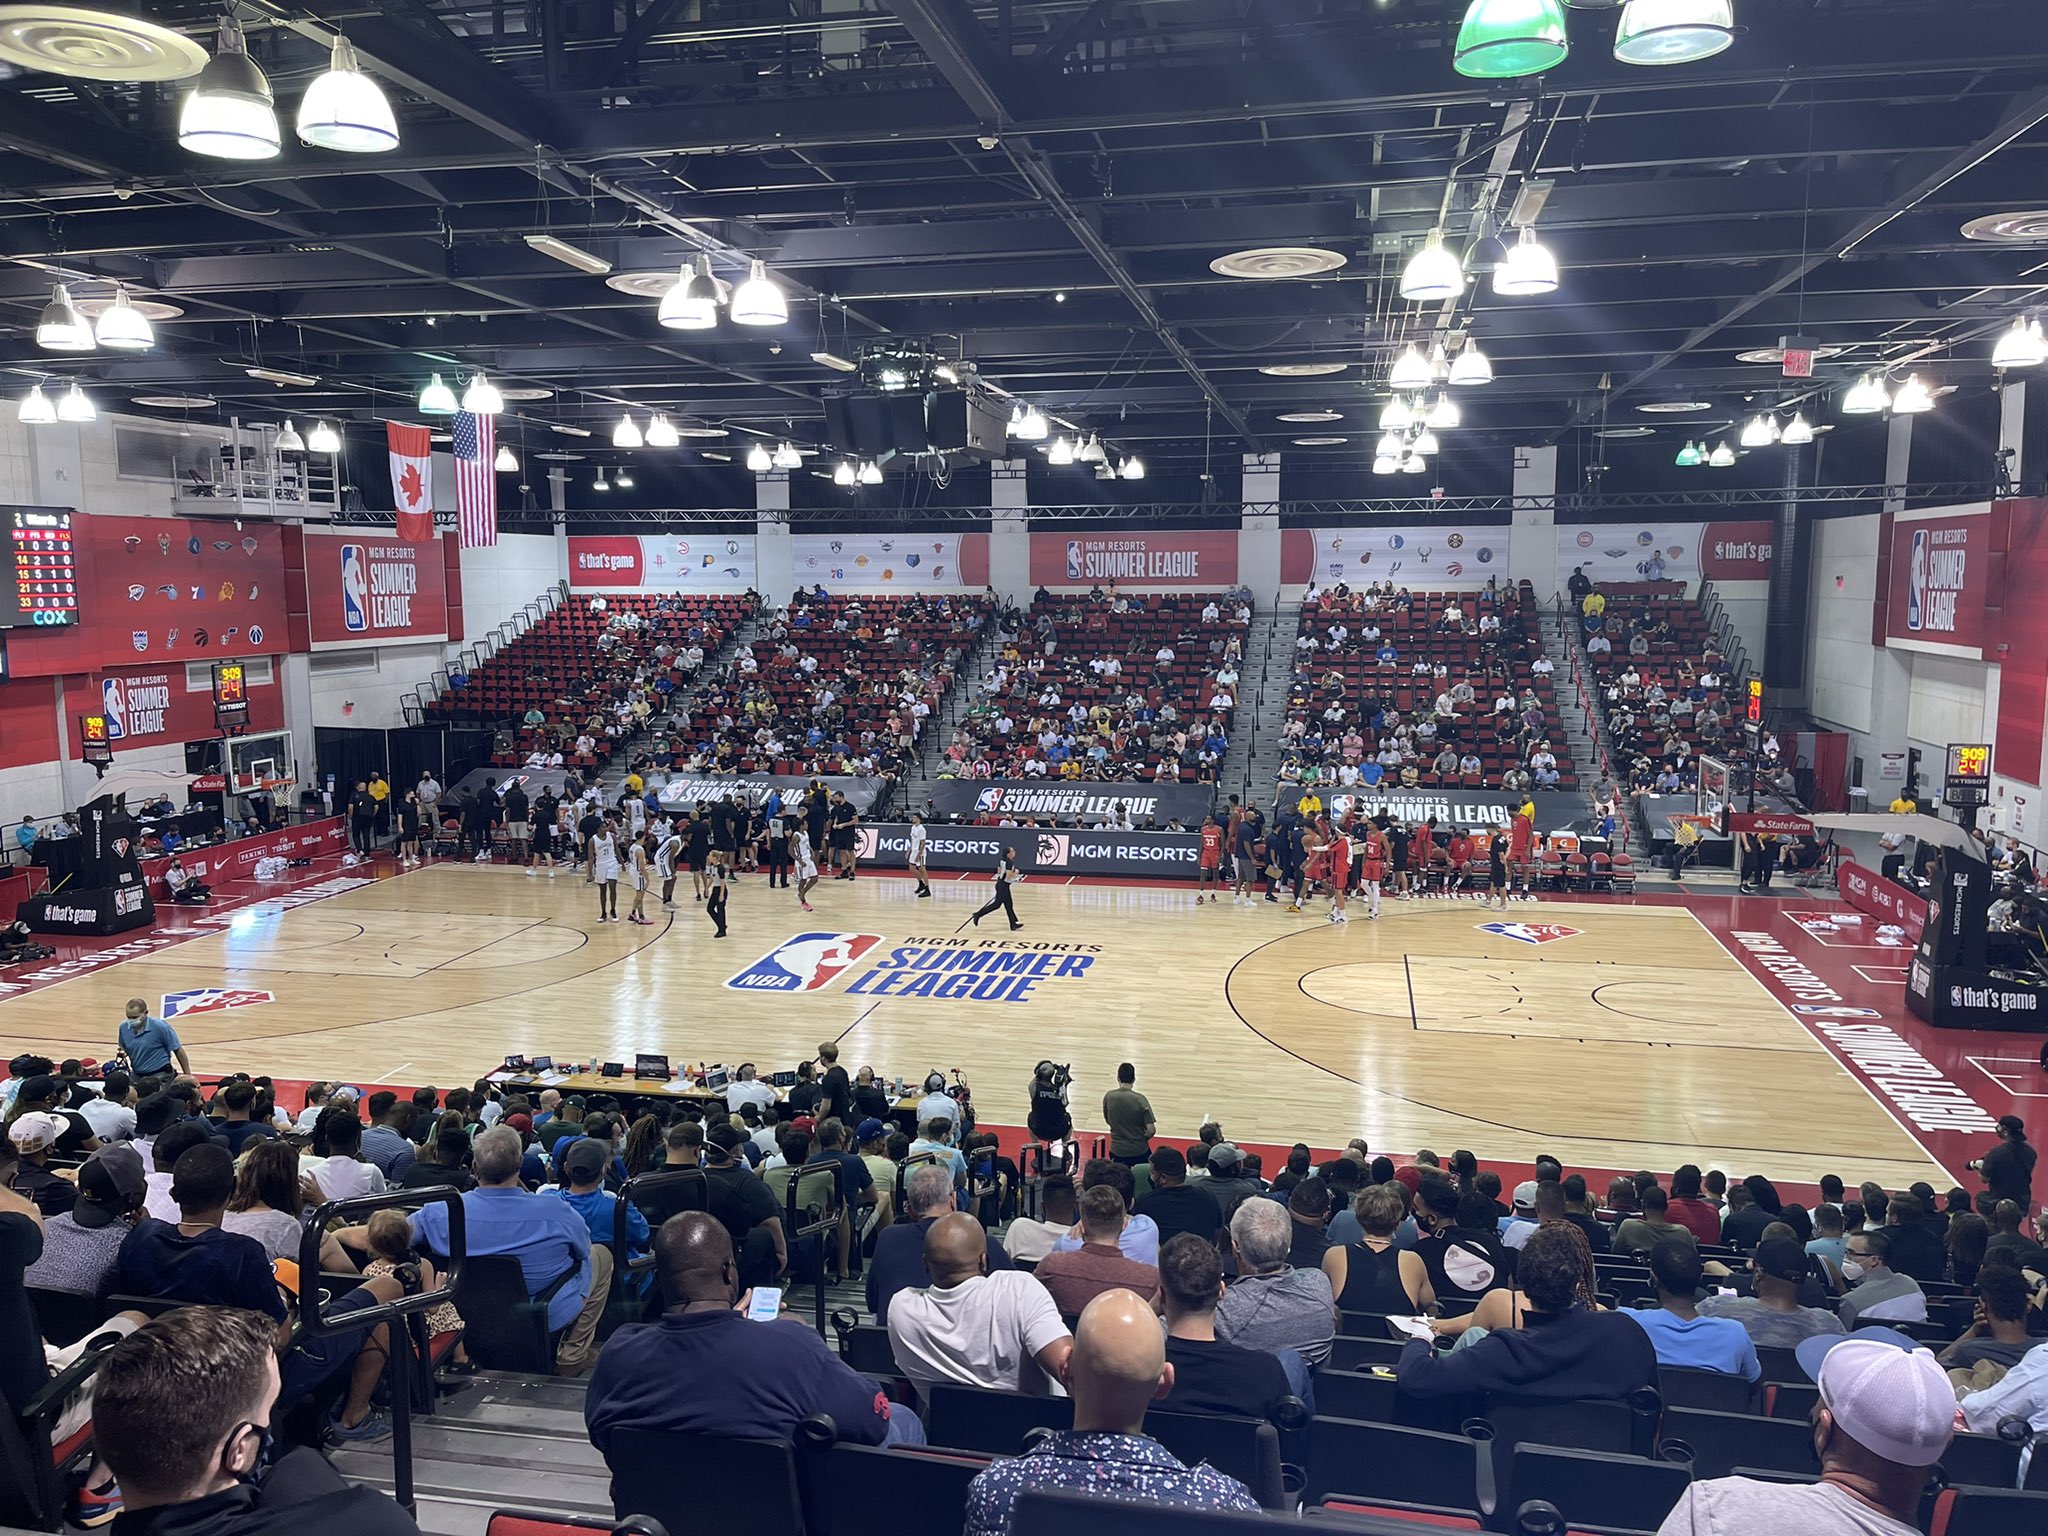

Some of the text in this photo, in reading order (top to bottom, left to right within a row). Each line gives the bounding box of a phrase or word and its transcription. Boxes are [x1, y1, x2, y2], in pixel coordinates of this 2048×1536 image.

[1944, 529, 1968, 544] RESORTS
[19, 541, 70, 550] 1 0 2 0
[368, 547, 416, 559] MGM RESORTS
[1086, 541, 1146, 551] MGM RESORTS
[1725, 542, 1756, 559] that's
[17, 555, 28, 564] 14
[34, 556, 40, 565] 2
[63, 555, 70, 564] 0
[586, 554, 634, 571] that's game
[1086, 552, 1199, 578] SUMMER LEAGUE
[18, 570, 30, 579] 15
[35, 570, 42, 578] 5
[64, 569, 72, 578] 0
[1928, 550, 1966, 590] SUMMER
[370, 563, 416, 594] SUMMER
[20, 584, 30, 592] 21
[36, 584, 42, 593] 4
[66, 584, 73, 592] 0
[20, 597, 74, 607] 33 0 0 0
[33, 610, 67, 625] COX
[372, 596, 412, 628] LEAGUE
[1926, 591, 1957, 631] LEAGUE
[126, 674, 168, 686] MGM RESORTS
[222, 680, 240, 700] 24
[128, 686, 170, 712] SUMMER
[129, 710, 165, 736] LEAGUE
[88, 727, 102, 738] 24
[1958, 760, 1980, 774] 24
[692, 780, 718, 788] MGM
[1006, 788, 1088, 796] MGM RESORTS
[1000, 795, 1084, 814] SUMMER
[1392, 796, 1448, 805] RESORTS
[1767, 820, 1810, 830] State Farm
[925, 840, 1000, 854] RESORTS
[1560, 839, 1568, 847] G
[240, 848, 266, 862] PANINI
[1070, 844, 1198, 862] MGM RESORTS
[52, 906, 97, 924] that's game
[1953, 903, 1962, 935] RESORTS
[903, 936, 1104, 952] MGM RESORTS
[18, 938, 170, 981] RESORTS
[876, 947, 1096, 978] SUMMER
[1730, 930, 1842, 1002] MGM RESORTS
[738, 974, 792, 987] NBA
[844, 969, 1045, 1002] LEAGUE
[1963, 987, 2037, 1012] that's game
[1815, 1022, 2000, 1134] SUMMER LEAGUE
